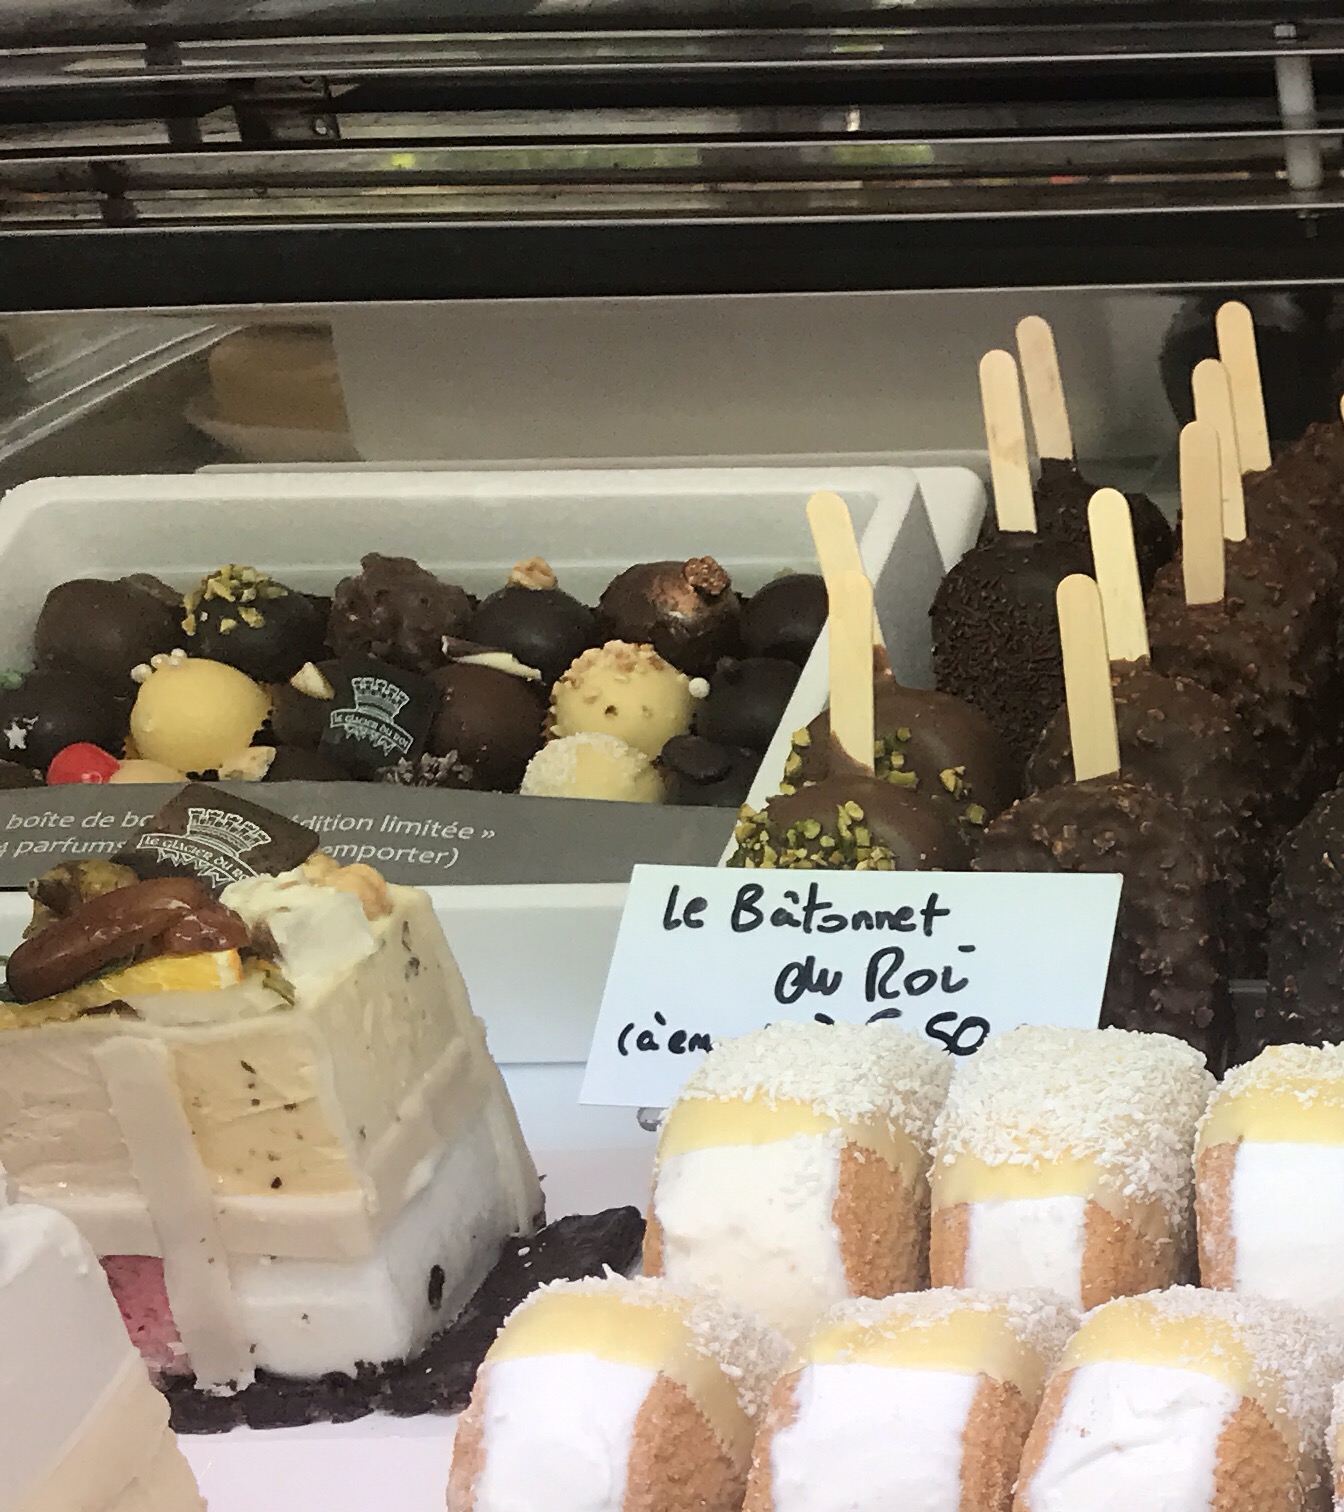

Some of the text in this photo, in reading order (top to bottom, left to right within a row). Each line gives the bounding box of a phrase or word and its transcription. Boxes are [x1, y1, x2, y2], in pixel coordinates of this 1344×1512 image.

[6, 811, 75, 831] boîte
[81, 811, 115, 829] de
[379, 814, 475, 840] limitée
[730, 881, 952, 938] Bâtonnet
[773, 944, 977, 1005] du Roi
